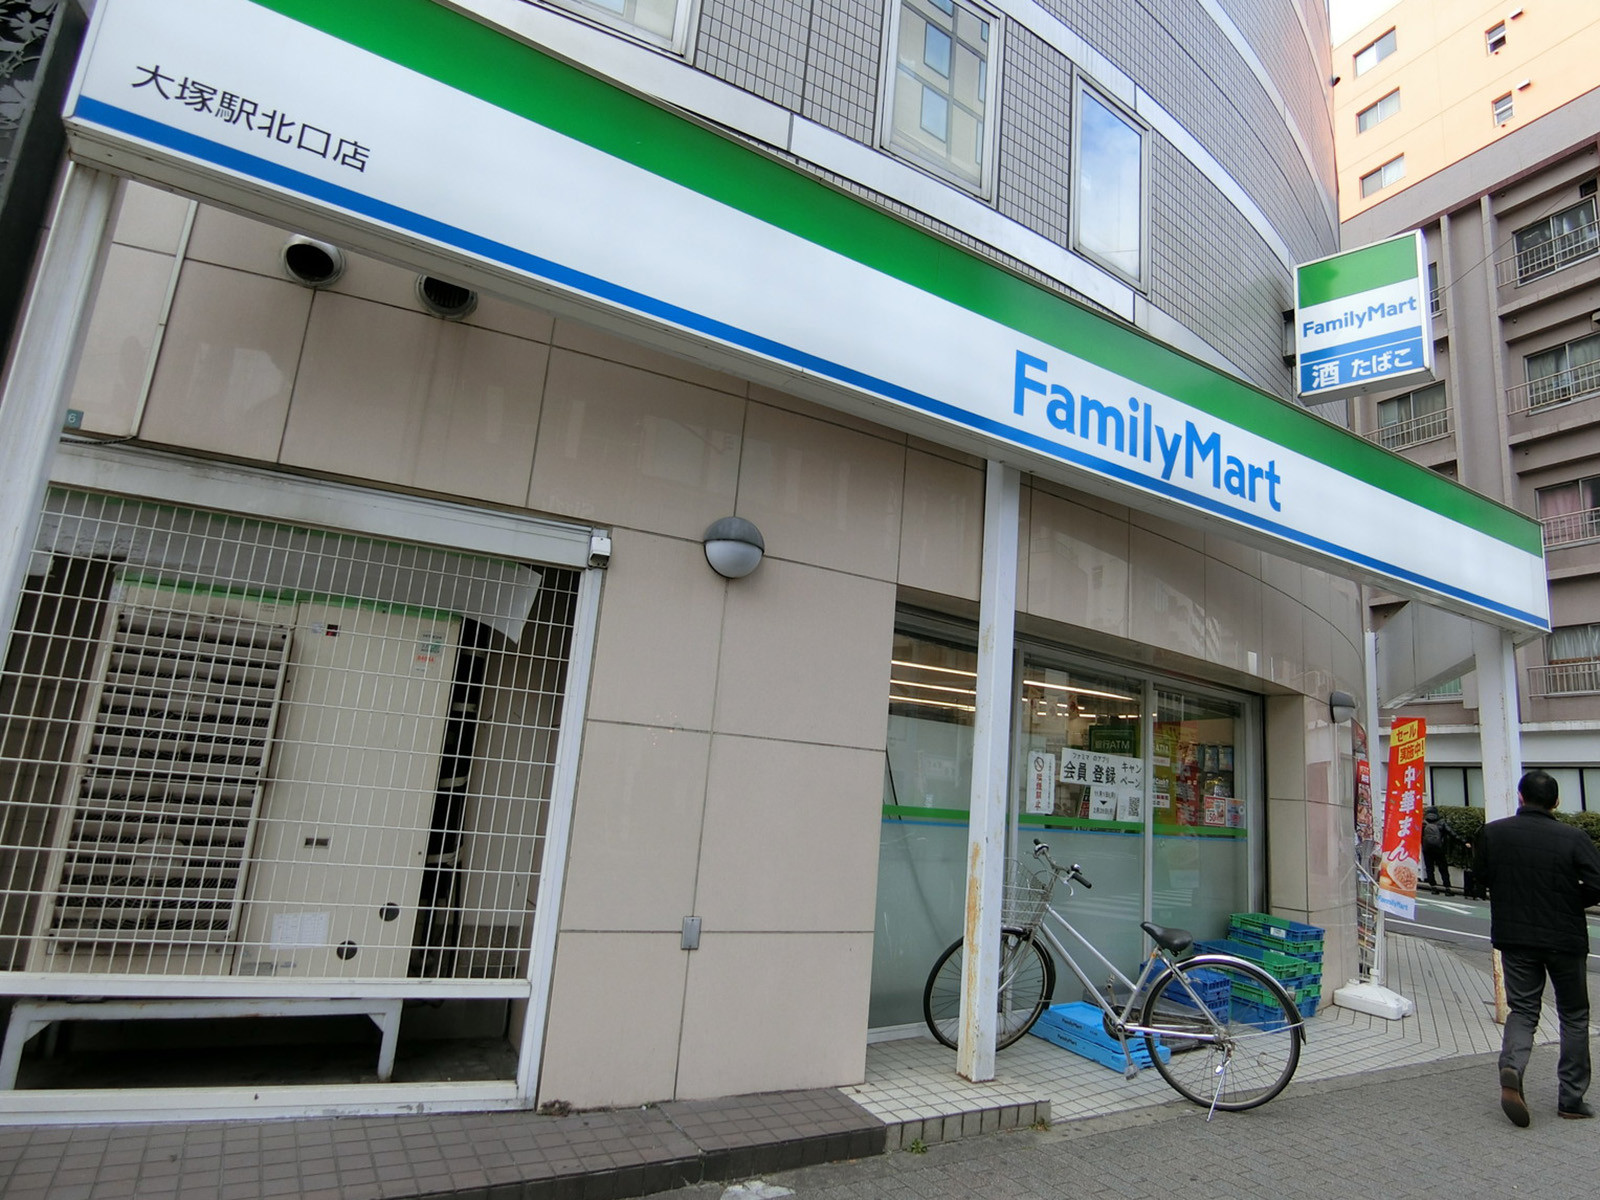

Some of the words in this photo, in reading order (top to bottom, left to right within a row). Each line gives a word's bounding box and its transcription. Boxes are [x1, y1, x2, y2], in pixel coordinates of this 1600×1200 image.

[131, 64, 371, 173] 大塚駅北口店
[1303, 296, 1417, 338] FamilyMart
[1311, 360, 1340, 389] 酒
[1351, 347, 1413, 378] たばこ
[1013, 349, 1281, 513] FamilyMart
[1396, 724, 1417, 743] セール
[1063, 760, 1087, 782] 会員
[1092, 764, 1116, 785] 登録
[1121, 762, 1142, 774] キャン
[1387, 765, 1417, 861] 中華まん
